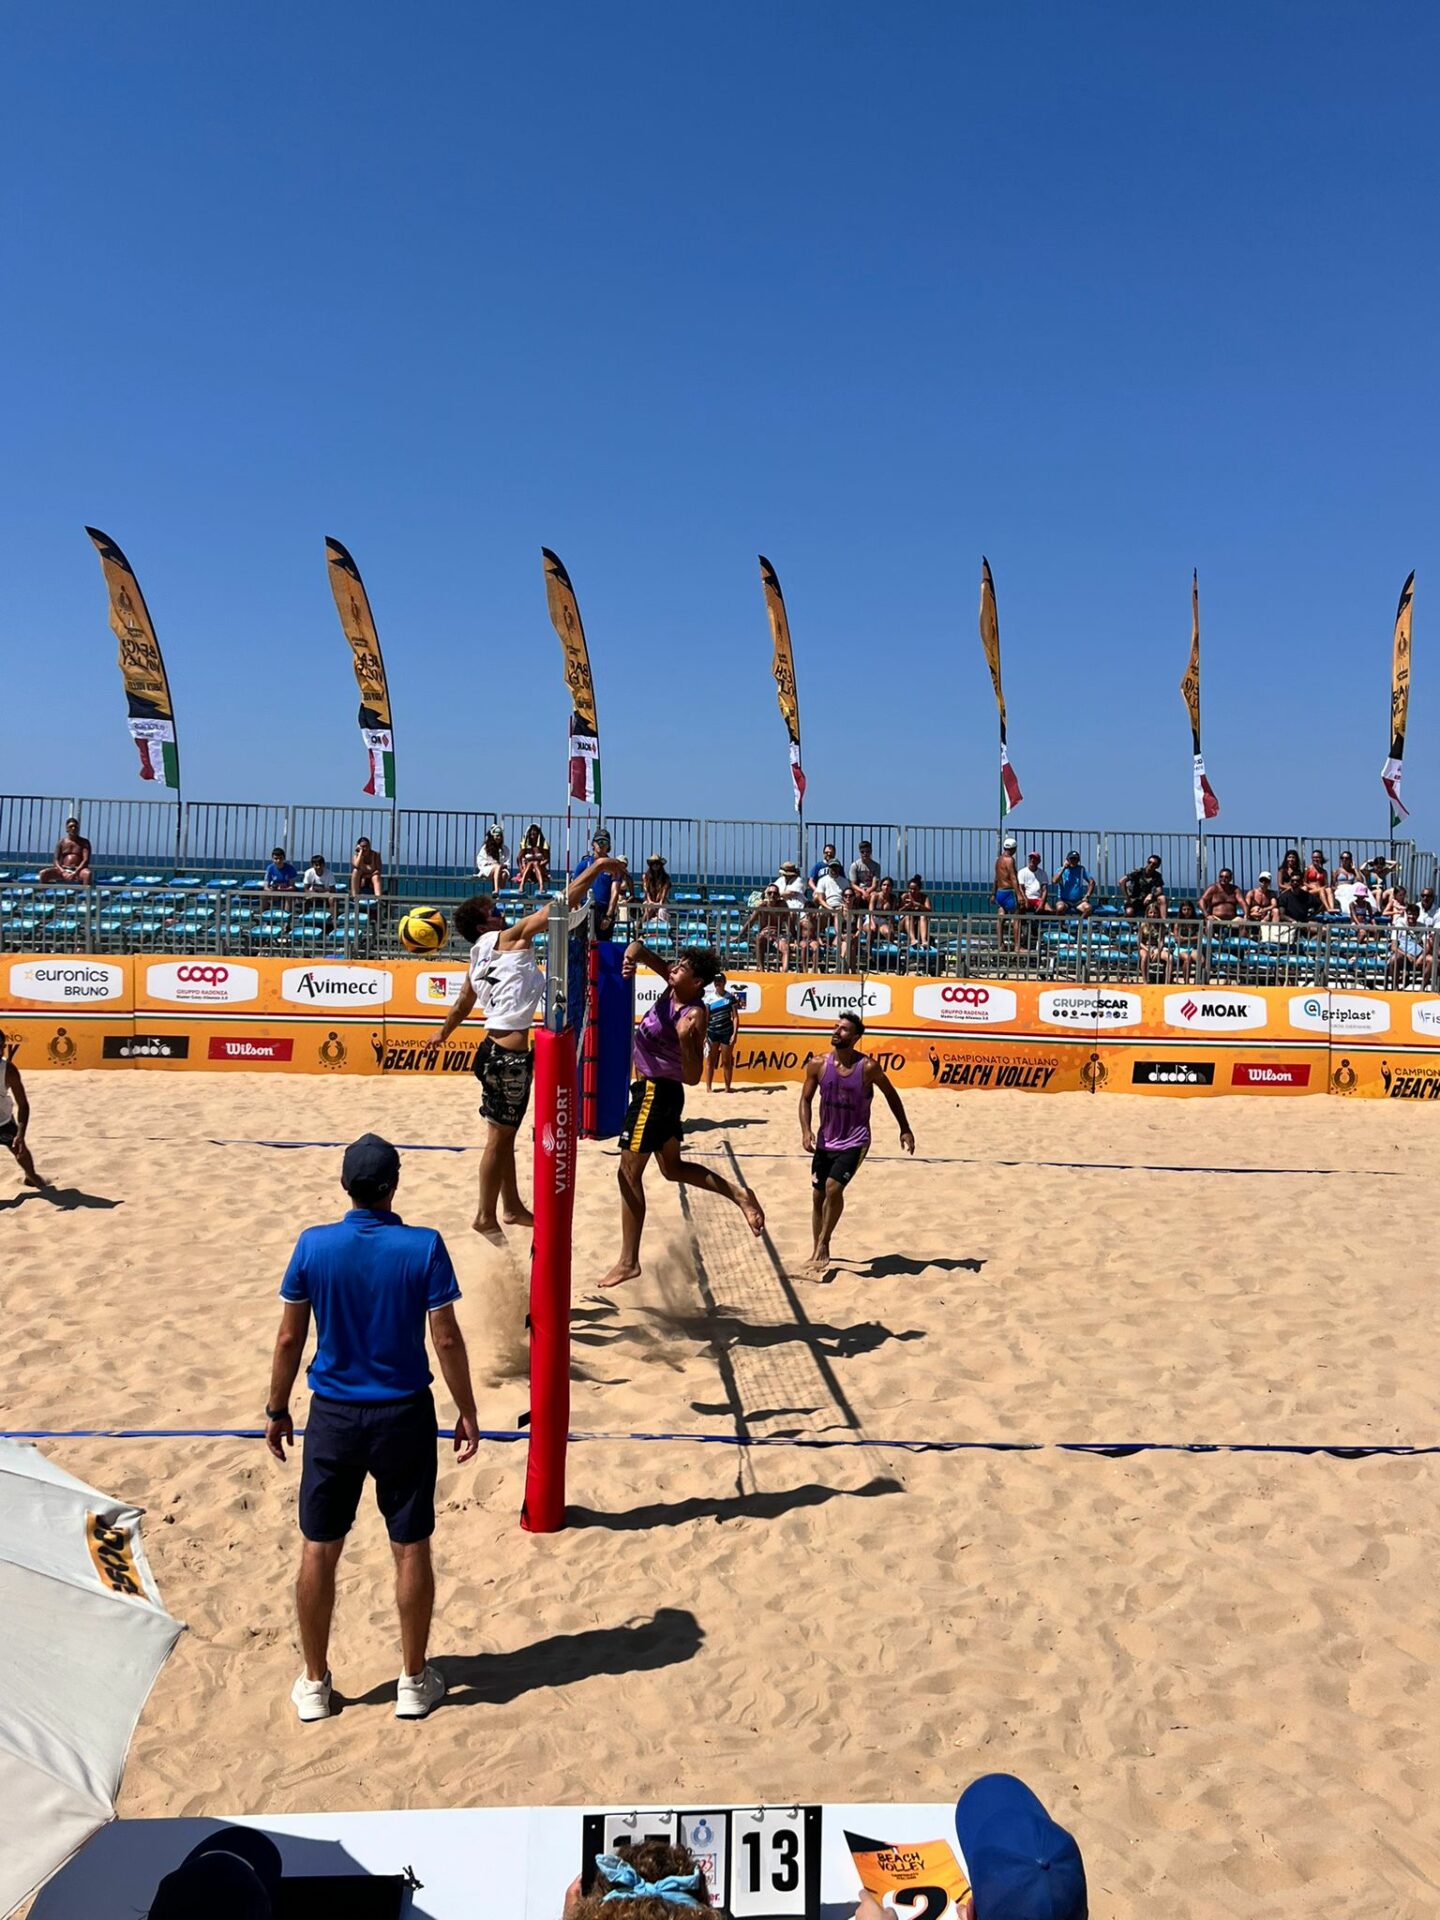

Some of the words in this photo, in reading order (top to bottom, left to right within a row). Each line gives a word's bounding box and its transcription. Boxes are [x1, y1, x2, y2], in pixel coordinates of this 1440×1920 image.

[35, 967, 109, 982] euronics
[177, 966, 229, 987] coop
[65, 986, 109, 996] BRUNO
[941, 987, 989, 1007] coop
[1201, 1004, 1247, 1018] MOAK
[225, 1043, 274, 1056] Wilson
[384, 1049, 440, 1071] BEACH
[943, 1054, 1010, 1064] CAMPIONATO
[1013, 1057, 1059, 1066] ITALIANO
[939, 1063, 994, 1085] BEACH
[995, 1066, 1056, 1088] VOLLEY
[1148, 1064, 1198, 1082] diadora
[1248, 1069, 1293, 1082] Wilson
[1390, 1077, 1440, 1099] BEACH
[555, 1085, 568, 1194] VIVISPORT
[742, 1829, 799, 1892] 13
[877, 1852, 920, 1864] BEACH
[878, 1860, 925, 1872] VOLLEY
